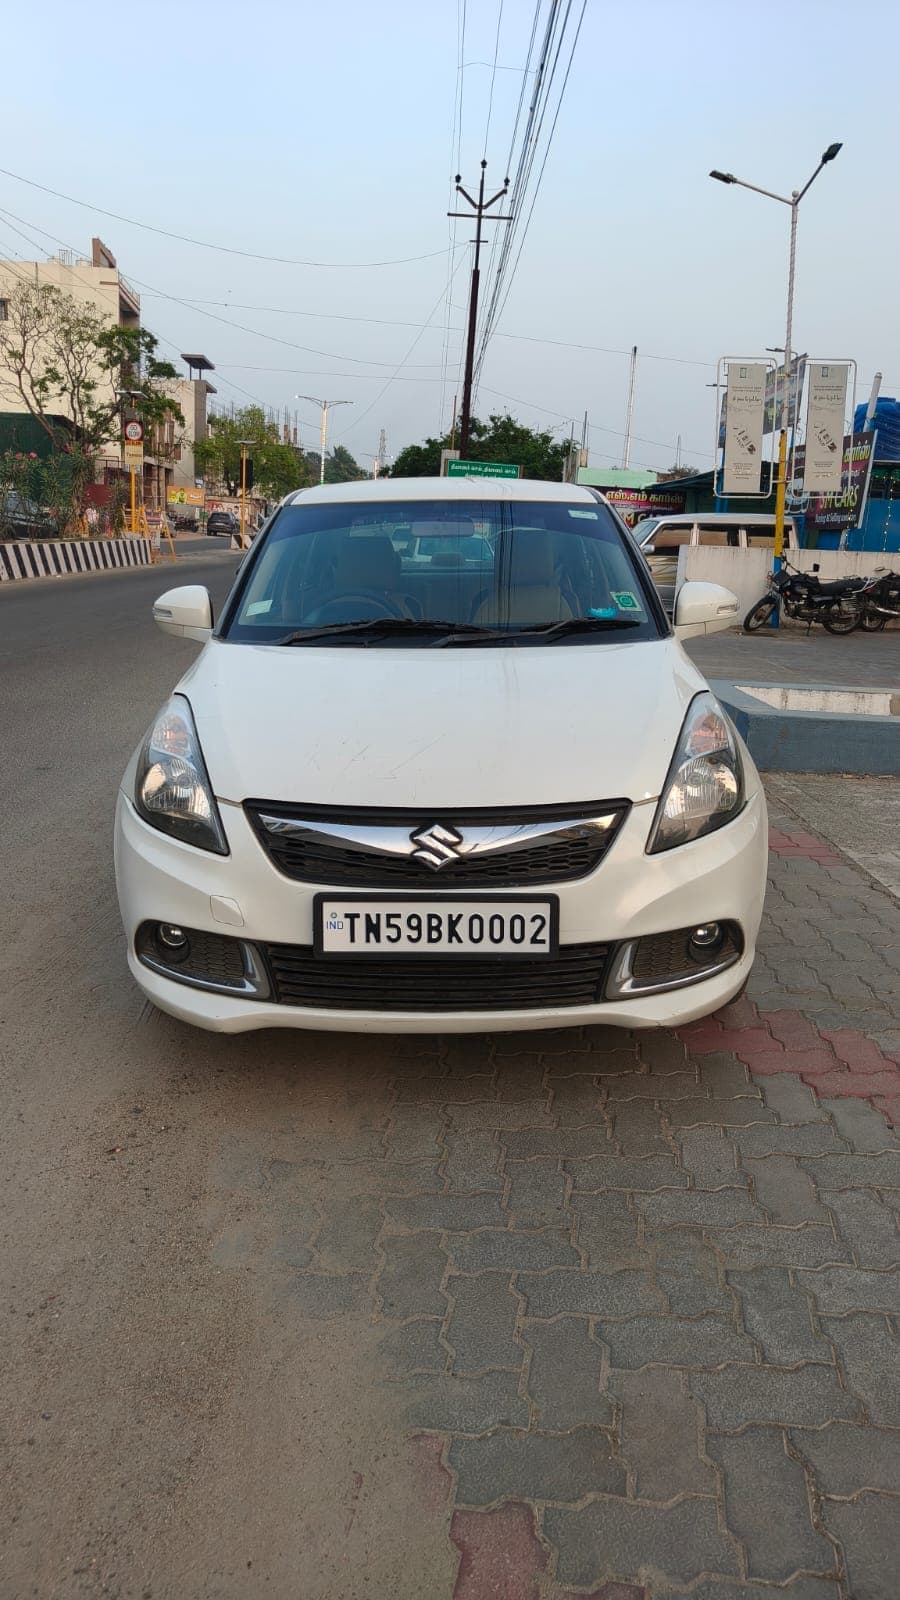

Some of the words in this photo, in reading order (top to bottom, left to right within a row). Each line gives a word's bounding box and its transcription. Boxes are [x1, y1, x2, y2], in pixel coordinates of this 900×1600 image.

[834, 485, 860, 508] CARS
[326, 920, 344, 930] IND
[343, 912, 548, 945] TN59BK0002
